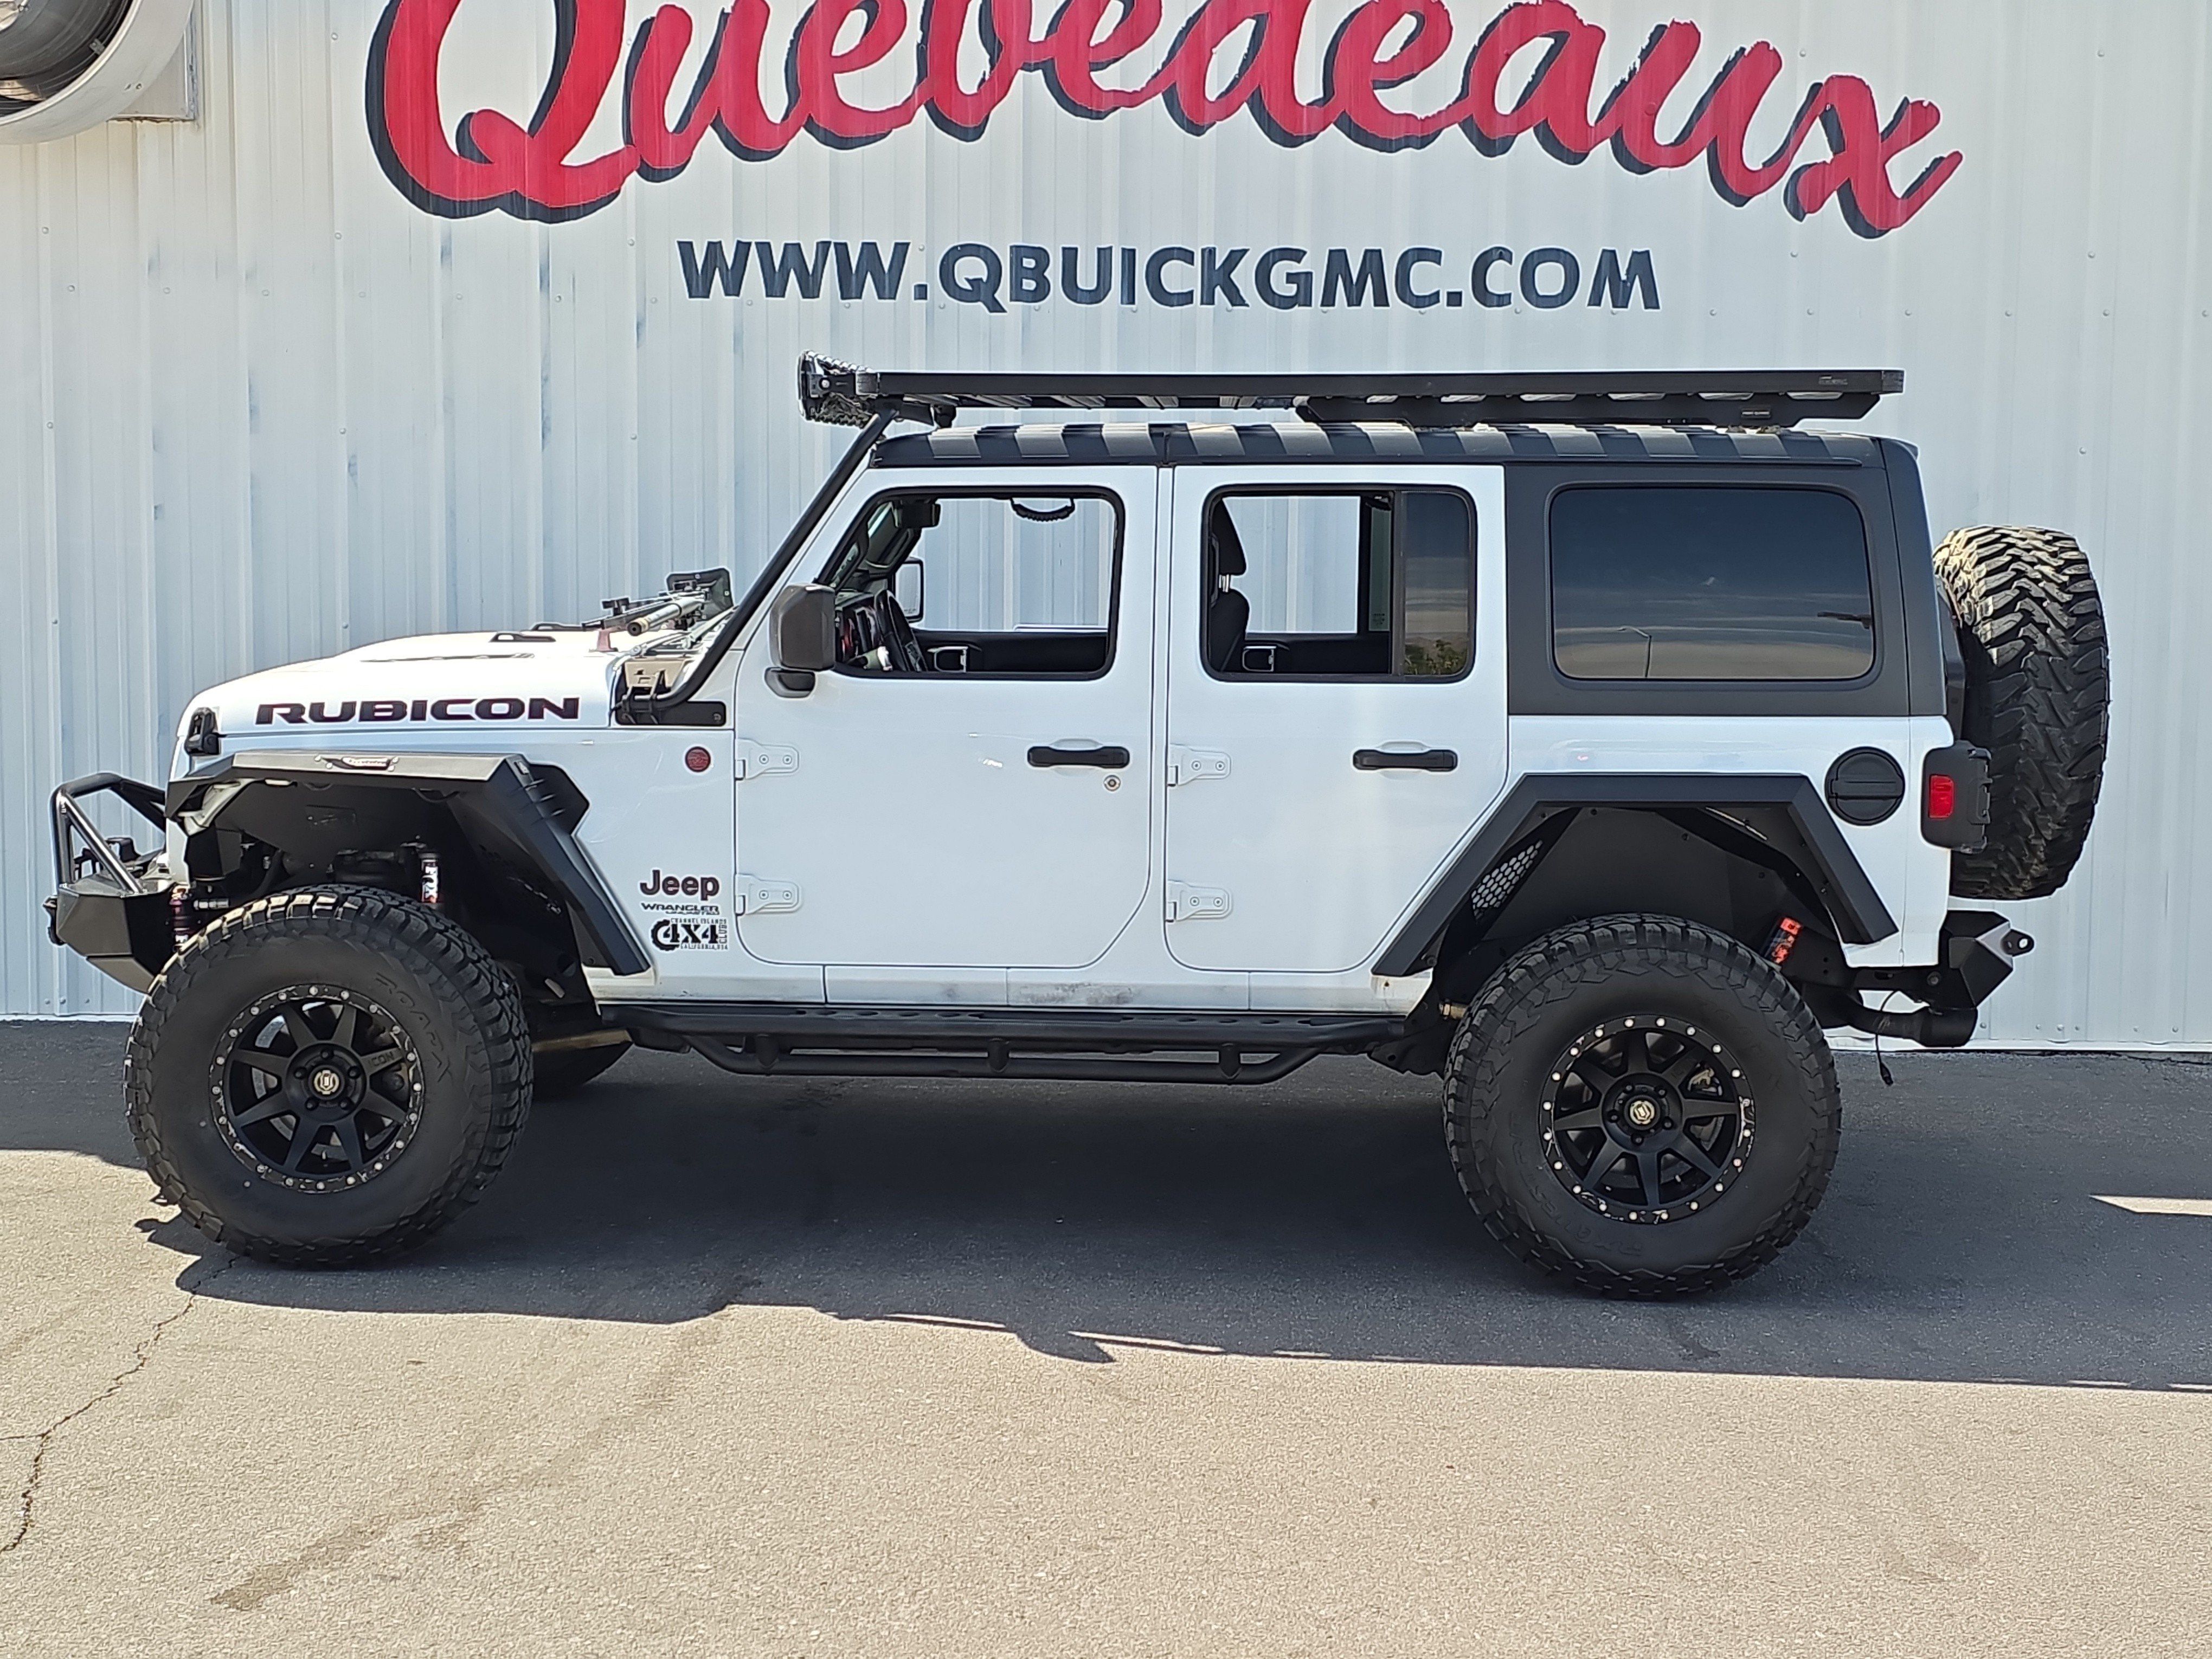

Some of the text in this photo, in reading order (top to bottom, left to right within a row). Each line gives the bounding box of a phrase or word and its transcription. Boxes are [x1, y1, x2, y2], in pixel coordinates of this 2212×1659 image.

[676, 240, 1660, 313] WWW.QBUICKGMC.COM
[255, 697, 580, 725] RUBICON
[640, 870, 719, 901] Jeep
[641, 903, 719, 911] WRANGLER
[369, 1051, 394, 1067] ICON
